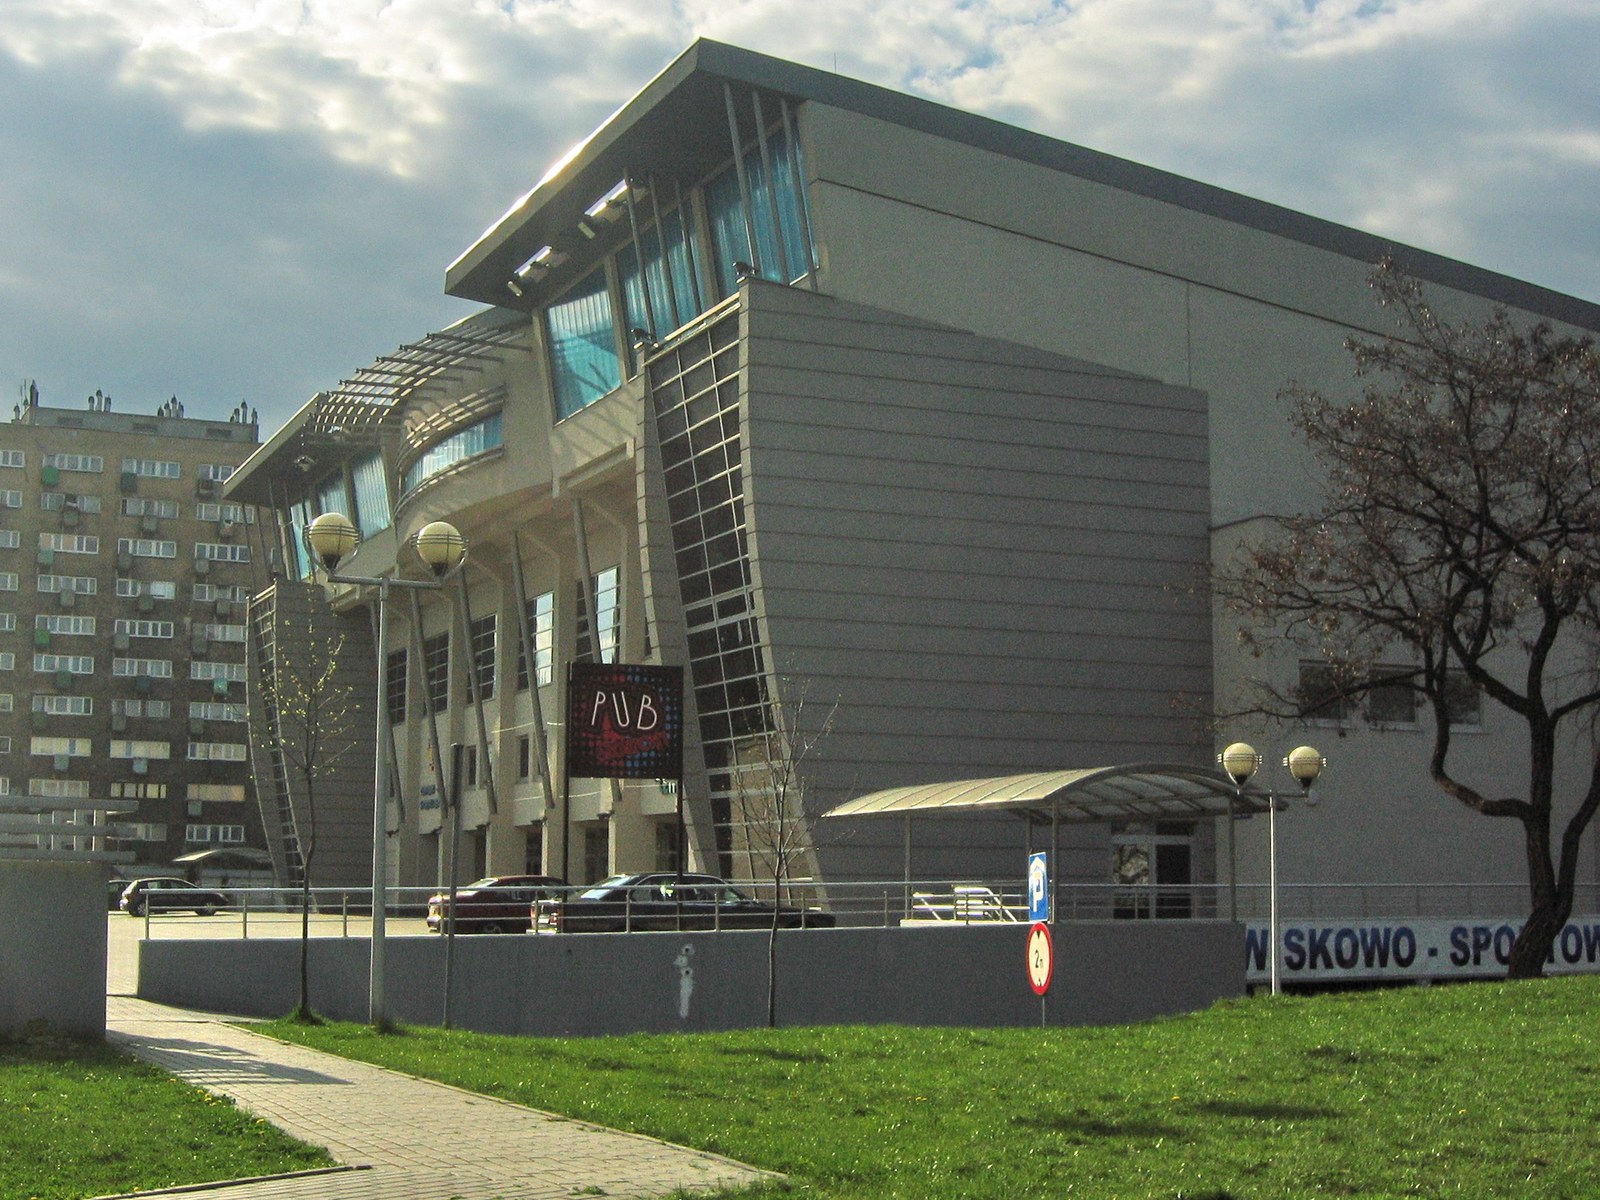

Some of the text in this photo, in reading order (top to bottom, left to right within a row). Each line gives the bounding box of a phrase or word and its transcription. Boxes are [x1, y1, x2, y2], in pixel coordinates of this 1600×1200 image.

[591, 690, 658, 730] PUB
[1032, 870, 1044, 913] P
[1245, 926, 1417, 972] WSKOWO
[1449, 924, 1600, 967] SPOOW
